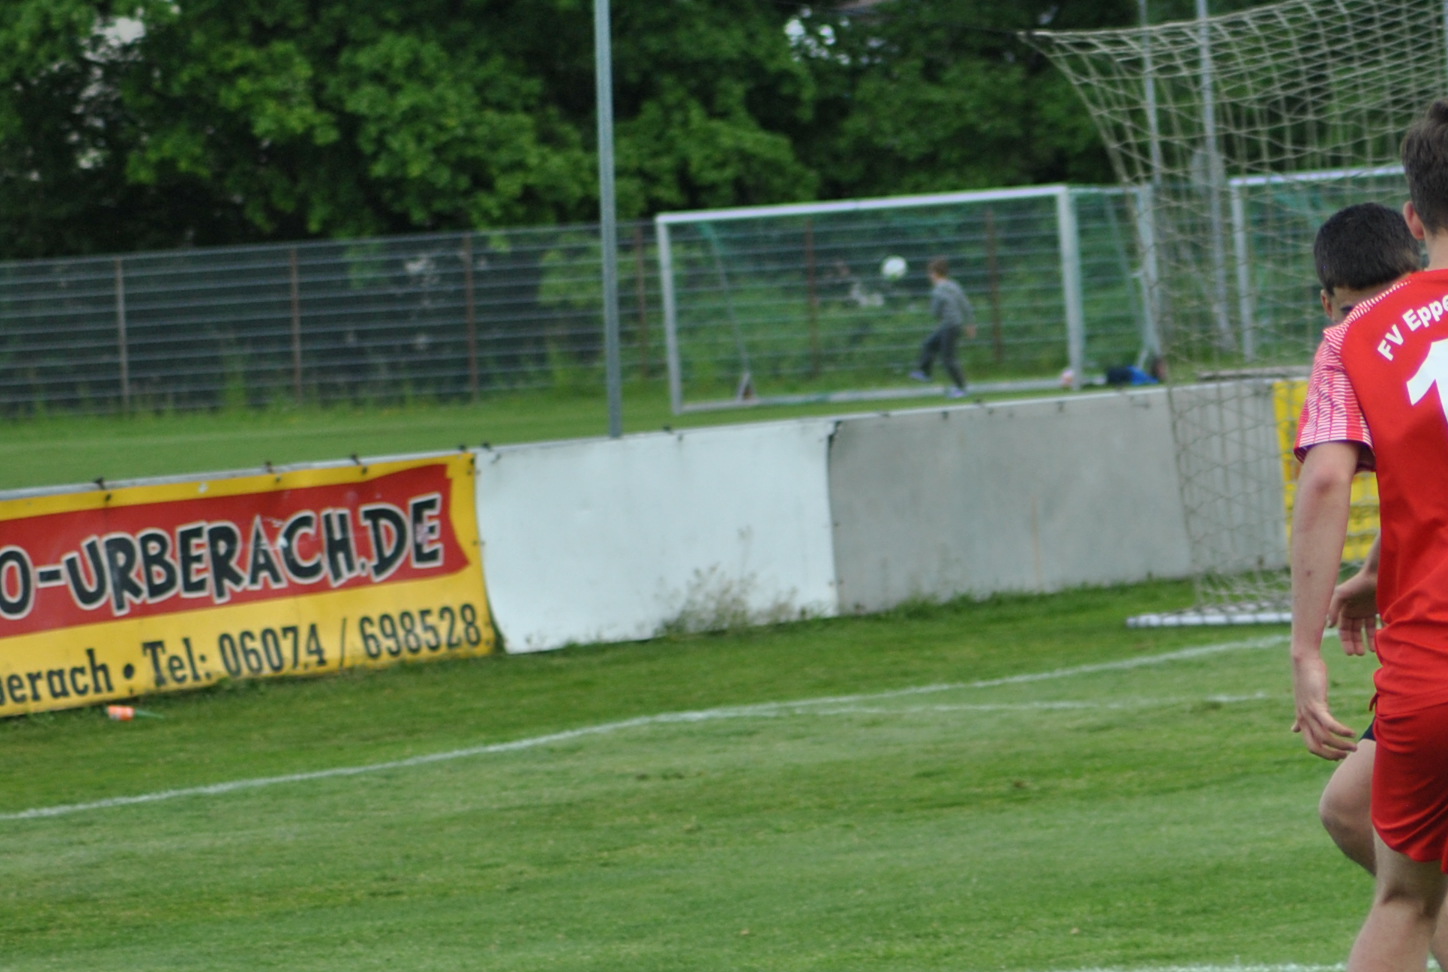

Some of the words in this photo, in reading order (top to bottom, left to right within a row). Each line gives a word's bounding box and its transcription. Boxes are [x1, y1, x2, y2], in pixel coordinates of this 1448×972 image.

[1377, 324, 1404, 361] FV
[0, 495, 442, 617] O-URBERACH.DE
[0, 648, 114, 706] erach
[143, 637, 212, 686] Tel:
[218, 623, 326, 677] 06074
[359, 603, 481, 660] 698528
